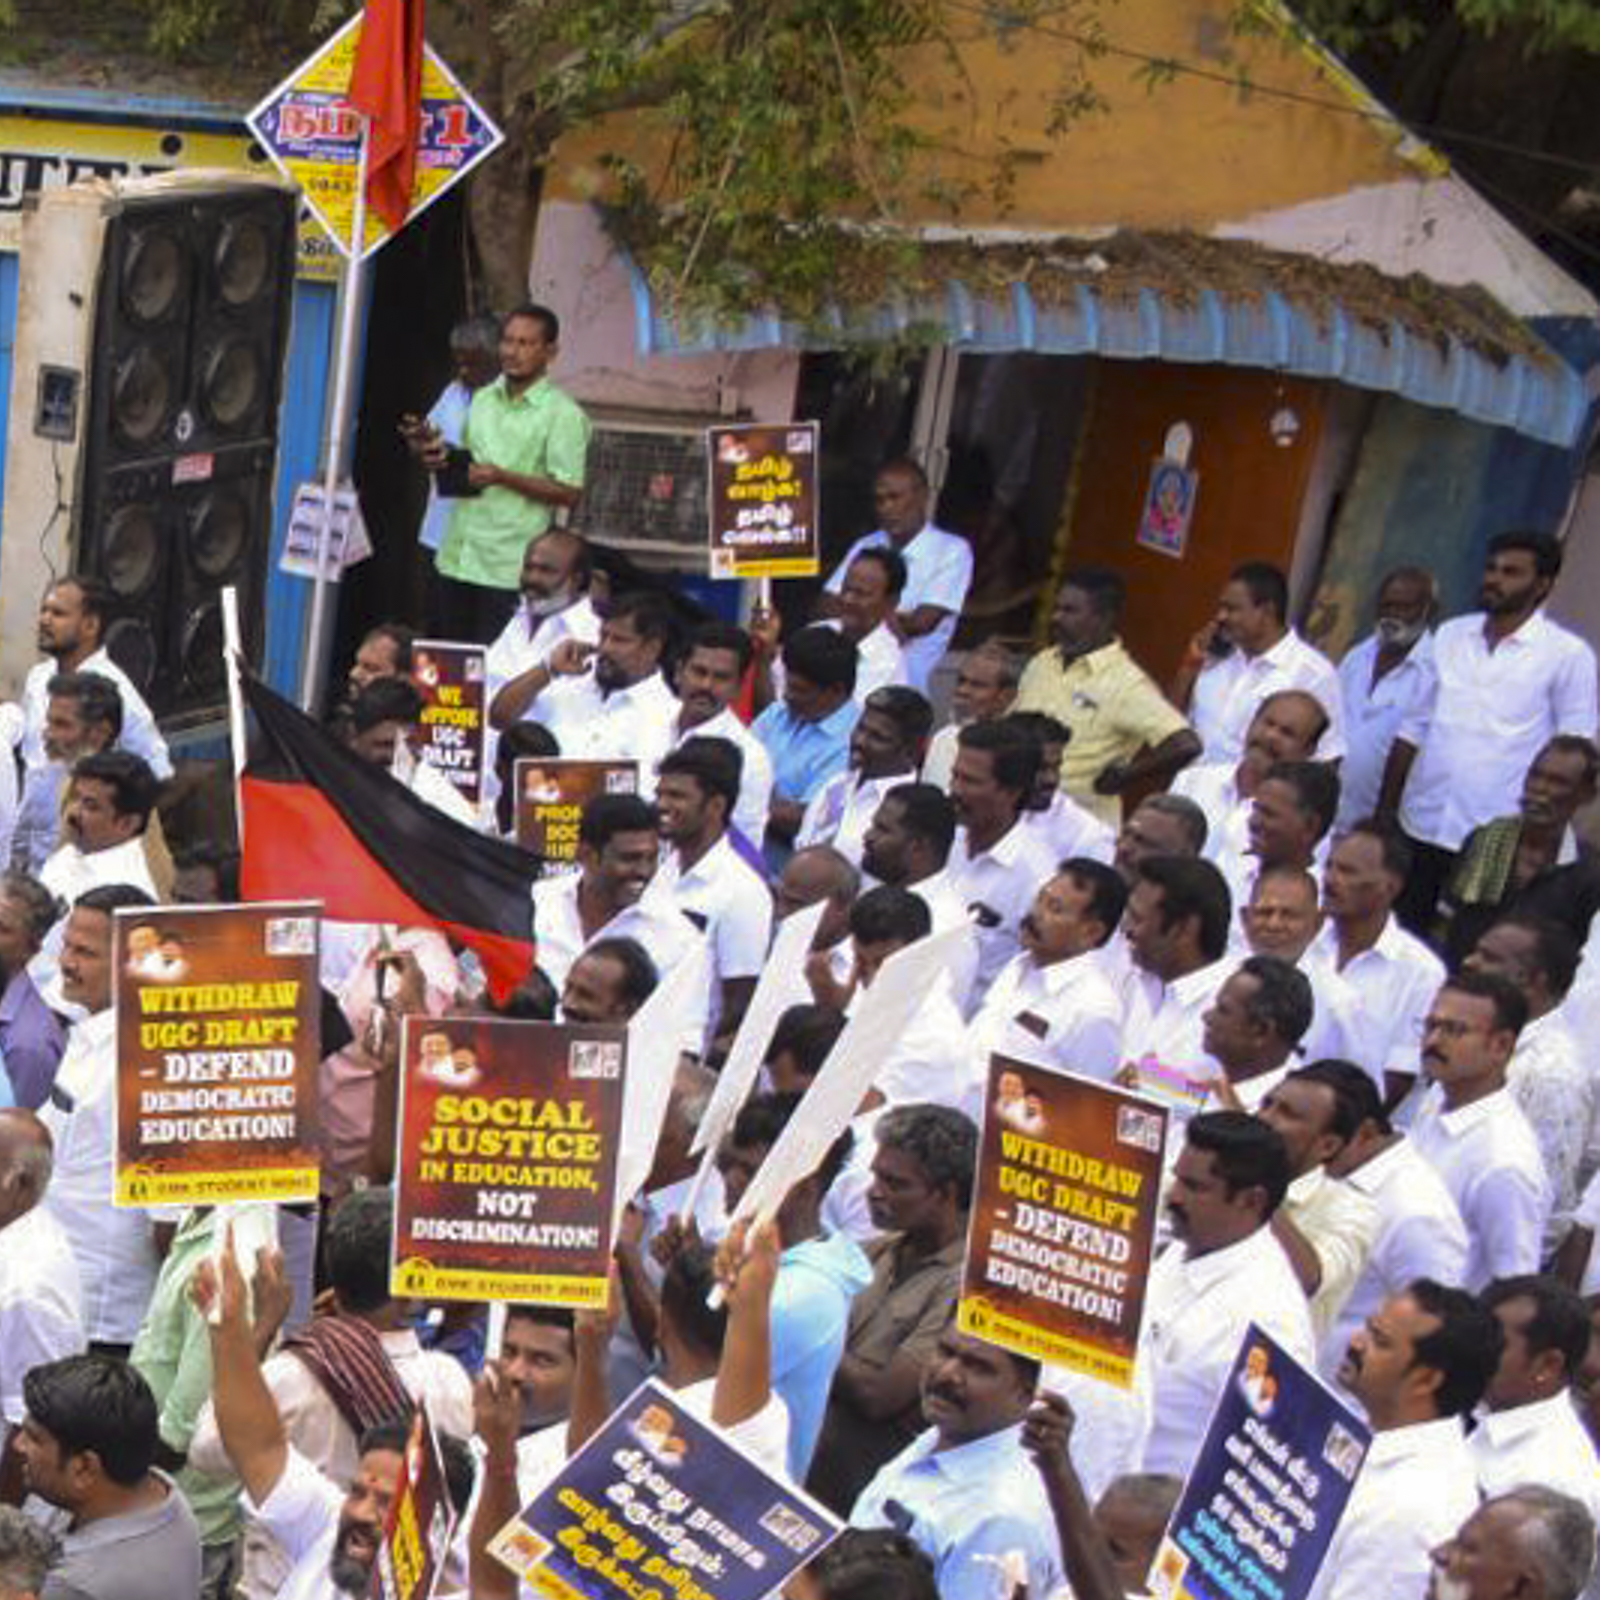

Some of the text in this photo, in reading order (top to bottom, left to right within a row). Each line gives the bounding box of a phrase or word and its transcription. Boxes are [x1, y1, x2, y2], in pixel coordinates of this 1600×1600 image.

[437, 686, 462, 705] WE
[139, 981, 300, 1014] WITHDRAW
[140, 1017, 299, 1050] UGC DRAFT
[163, 1049, 294, 1082] DEFEND
[140, 1085, 296, 1114] DEMOCRATIC
[434, 1095, 594, 1130] SOCIAL
[139, 1115, 297, 1144] EDUCATION!
[419, 1127, 603, 1164] JUSTICE
[419, 1162, 600, 1193] IN EDUCATION,
[999, 1130, 1144, 1199] WITHDRAW
[476, 1191, 538, 1218] NOT
[997, 1166, 1139, 1232] UGC DRAFT
[410, 1217, 600, 1249] DISCRIMINATION!
[1013, 1202, 1132, 1263] DEFEND
[989, 1230, 1129, 1294] DEMOCRATIC
[985, 1256, 1125, 1324] EDUCATION!
